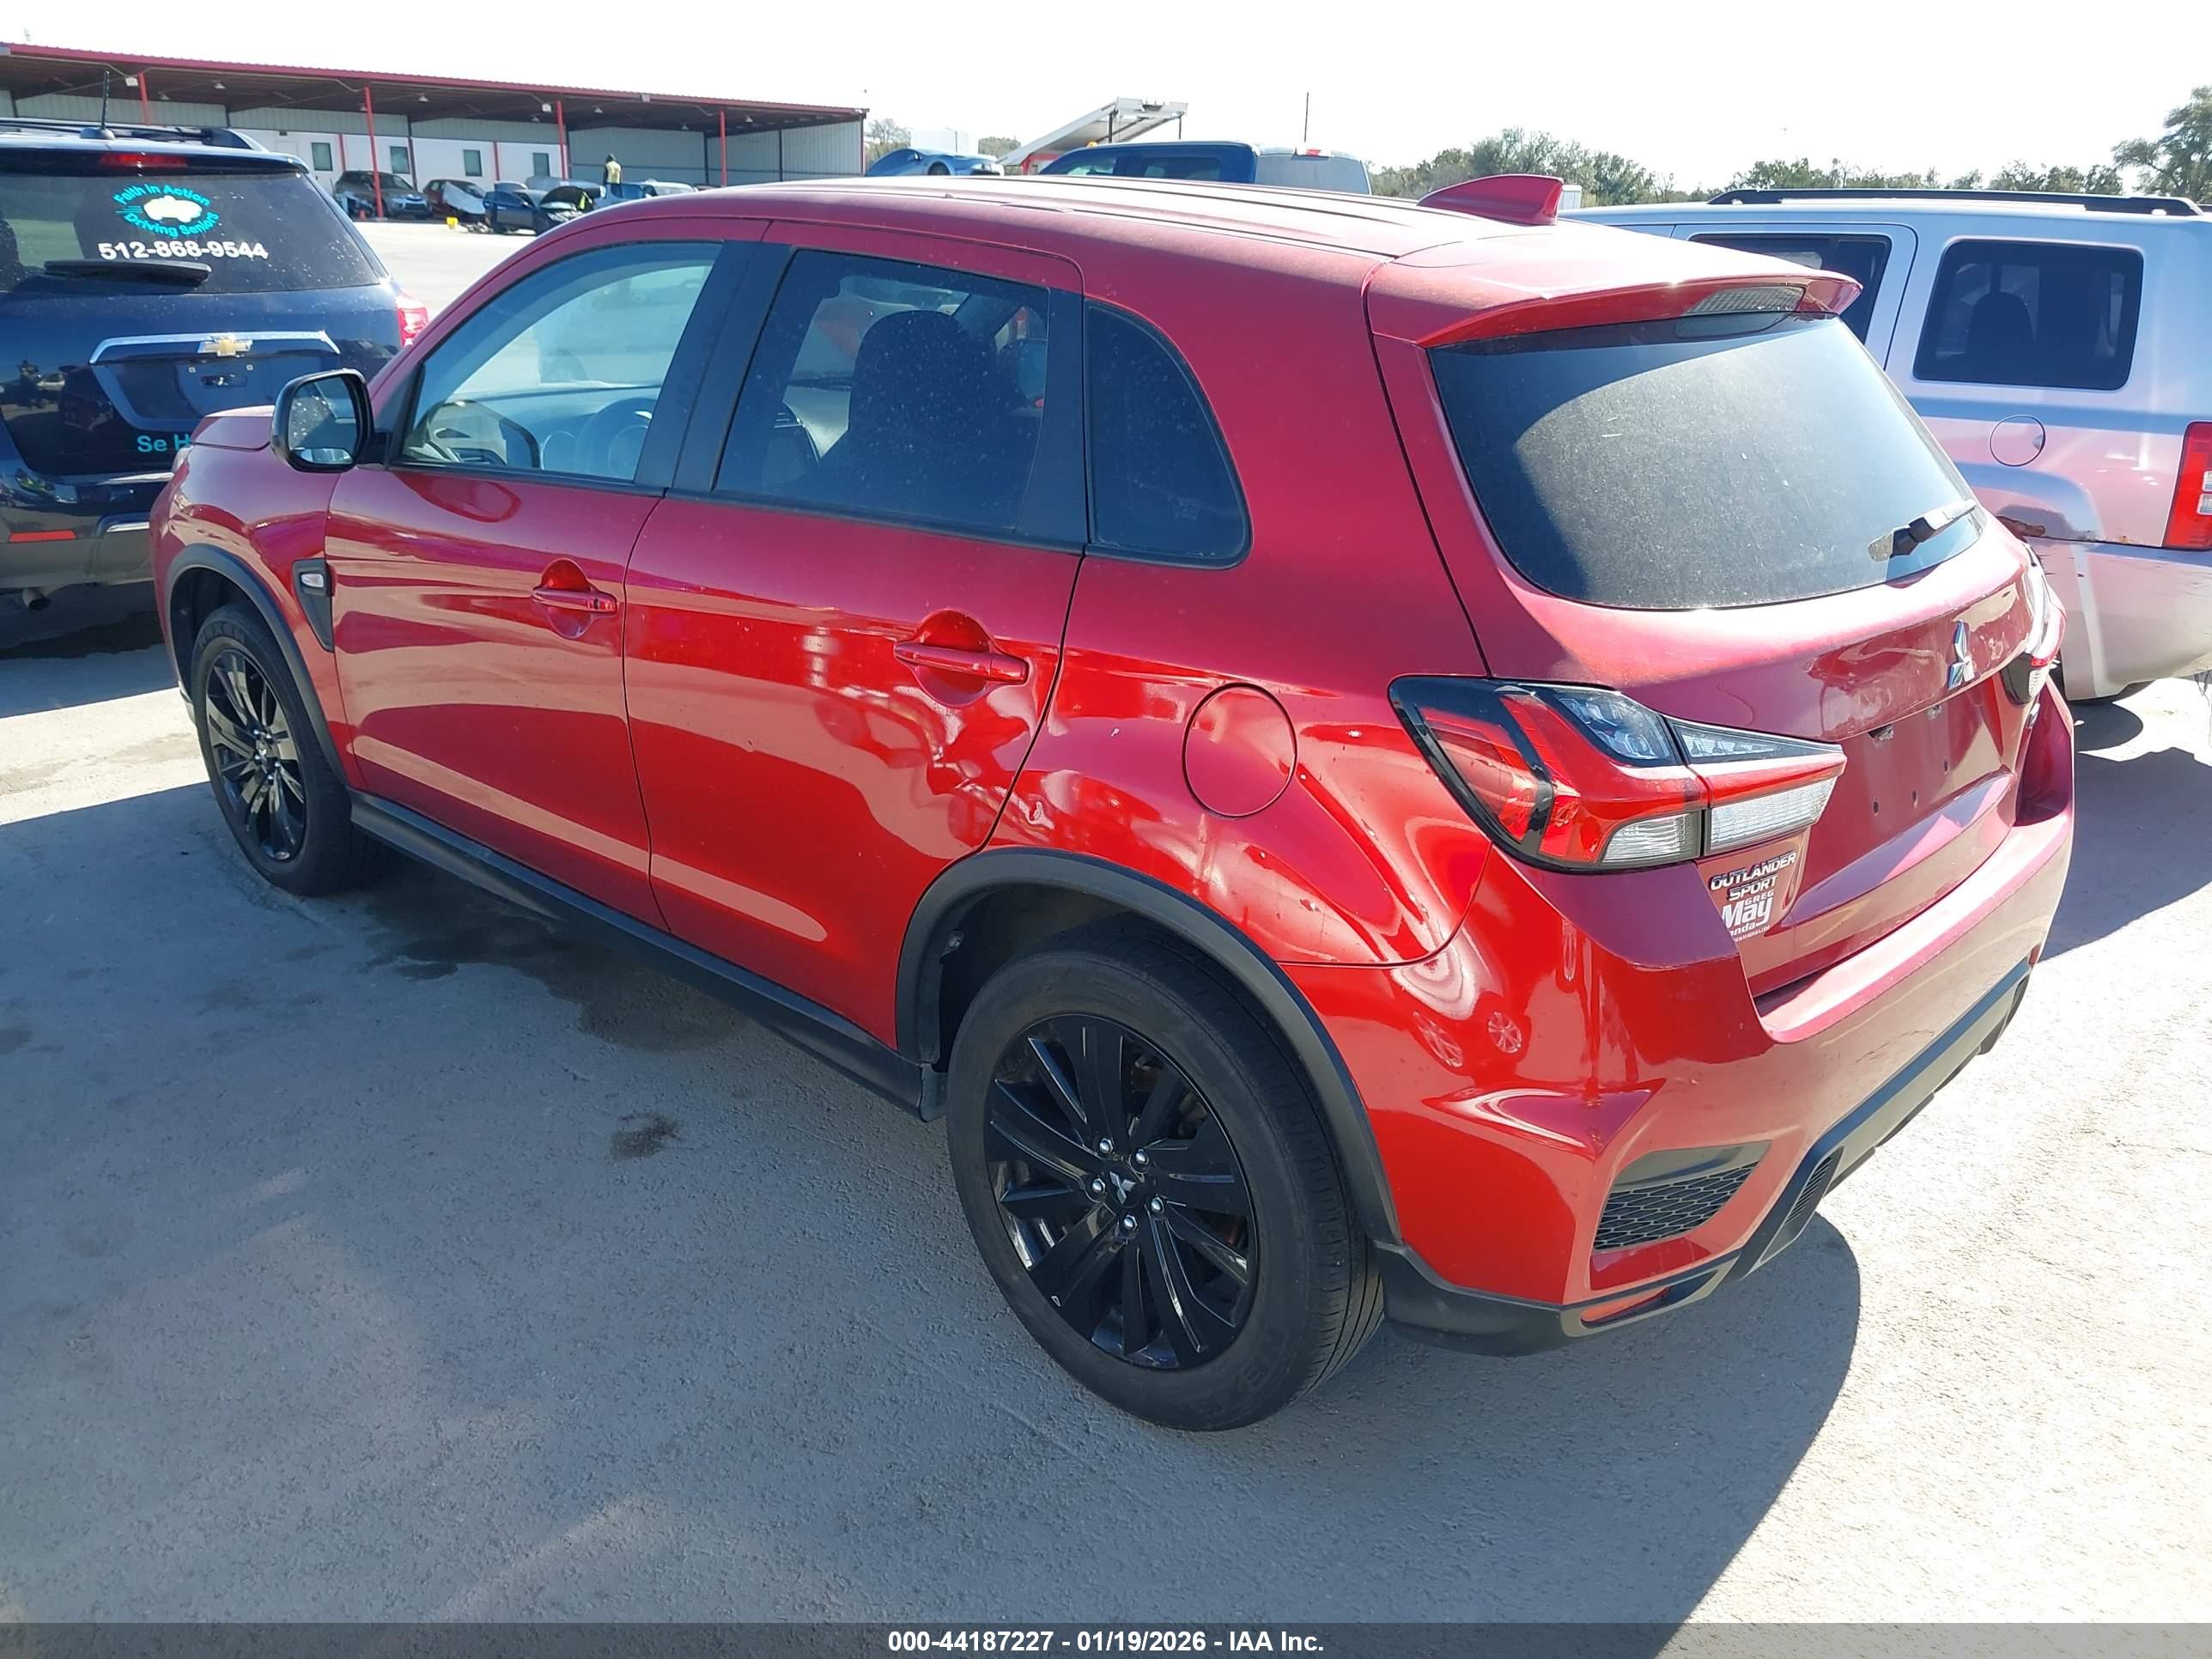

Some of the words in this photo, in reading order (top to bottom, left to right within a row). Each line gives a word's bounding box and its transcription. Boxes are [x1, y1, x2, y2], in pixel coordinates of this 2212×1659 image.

[113, 185, 146, 205] Faith
[144, 183, 161, 194] In
[163, 184, 210, 207] Action
[124, 212, 178, 238] Driving
[179, 211, 220, 235] Seniors
[98, 240, 269, 260] 512-868-9544
[137, 434, 167, 453] Se
[1709, 850, 1796, 890] OUTLANDER
[1727, 872, 1778, 901] SPORT
[1745, 889, 1774, 906] GREG
[1722, 896, 1773, 929] May
